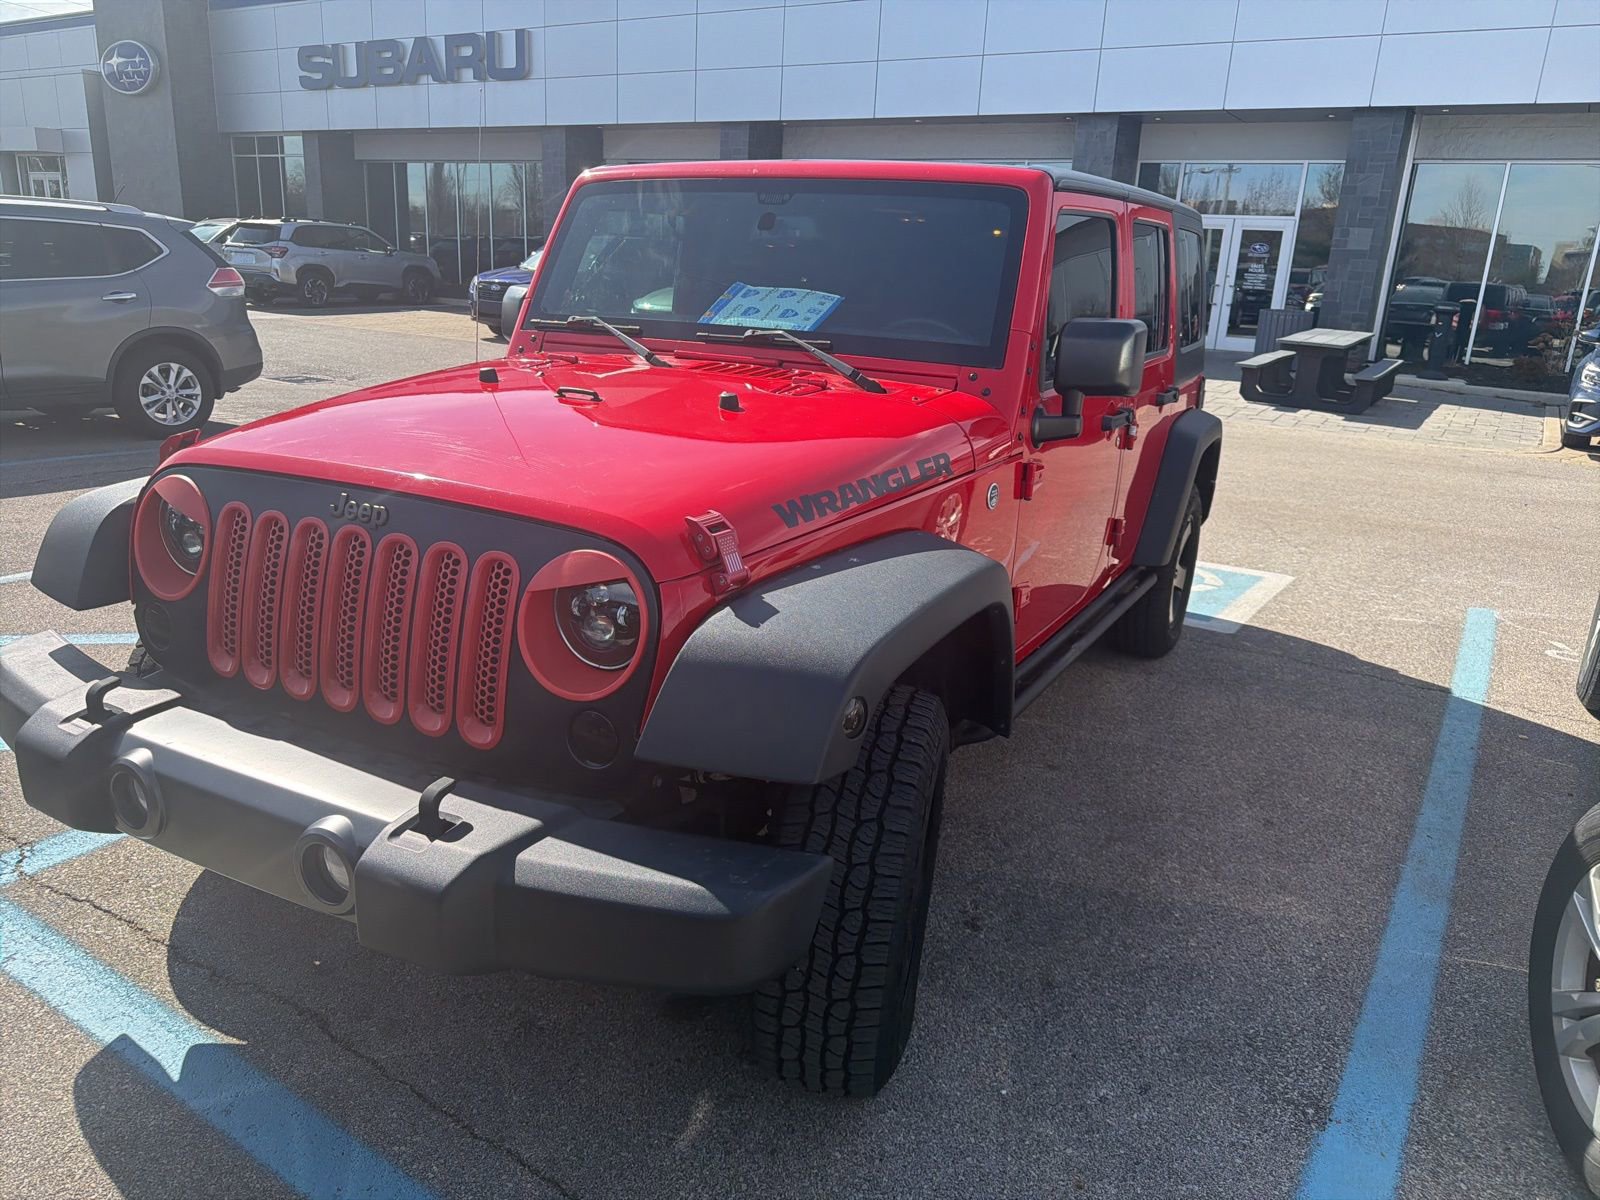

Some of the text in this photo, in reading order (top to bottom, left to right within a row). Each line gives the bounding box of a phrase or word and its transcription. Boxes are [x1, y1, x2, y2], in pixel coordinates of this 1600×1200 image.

[298, 28, 530, 90] SUBARU
[329, 492, 388, 529] Jeep
[771, 452, 954, 529] WRANGLER
